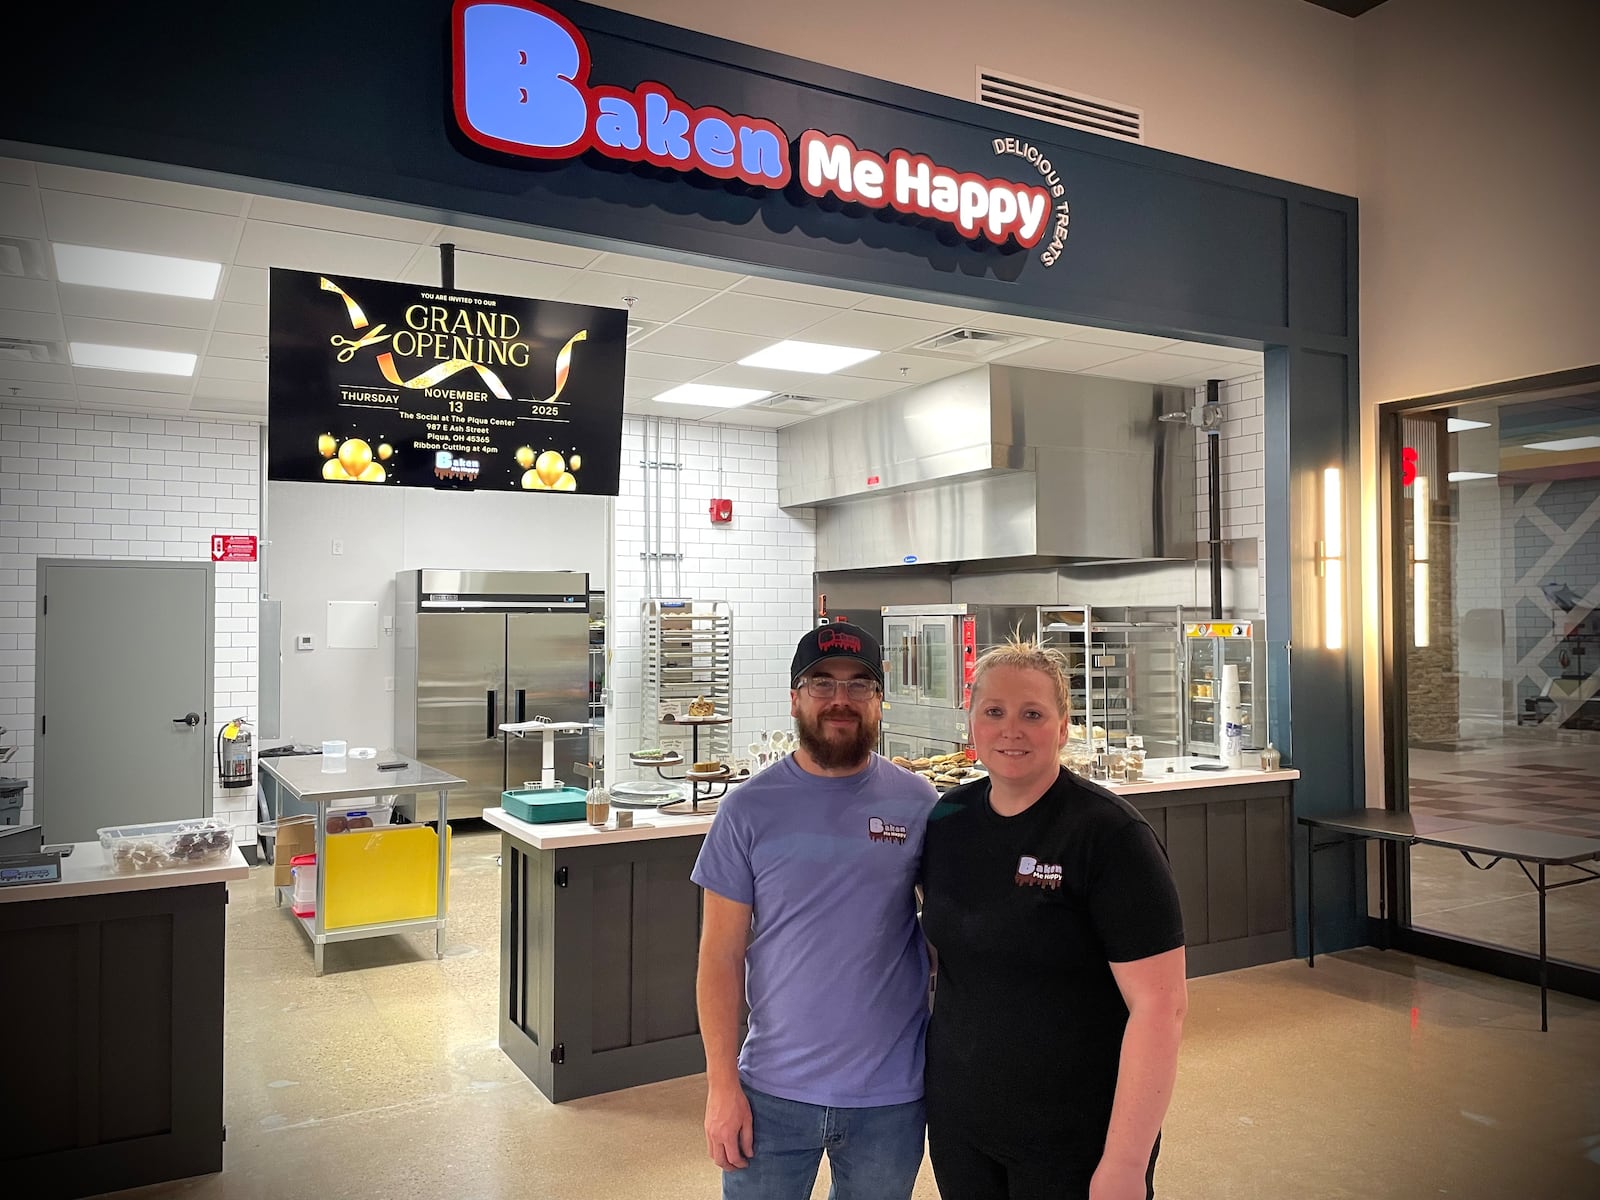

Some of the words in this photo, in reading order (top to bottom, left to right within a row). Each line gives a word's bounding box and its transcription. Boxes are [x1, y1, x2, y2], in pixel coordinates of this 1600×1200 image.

[458, 0, 787, 183] Baken
[806, 138, 885, 200] Me
[895, 157, 1046, 241] Happy
[993, 138, 1065, 198] DELICIOUS
[1041, 201, 1069, 267] TREATS
[449, 296, 473, 304] INVITED
[406, 305, 520, 339] GRAND
[393, 331, 529, 367] OPENING
[341, 391, 400, 404] THURSDAY
[425, 388, 488, 402] NOVEMBER
[449, 401, 464, 413] 13
[532, 406, 558, 416] 2025
[400, 411, 414, 419] The
[416, 412, 439, 421] Social
[451, 415, 465, 423] The
[467, 417, 488, 425] Piqua
[490, 418, 515, 426] Center
[466, 426, 489, 434] Street
[427, 433, 451, 441] Piqua,
[466, 435, 490, 443] 45365
[413, 441, 440, 449] Ribbon
[442, 443, 470, 452] Cutting
